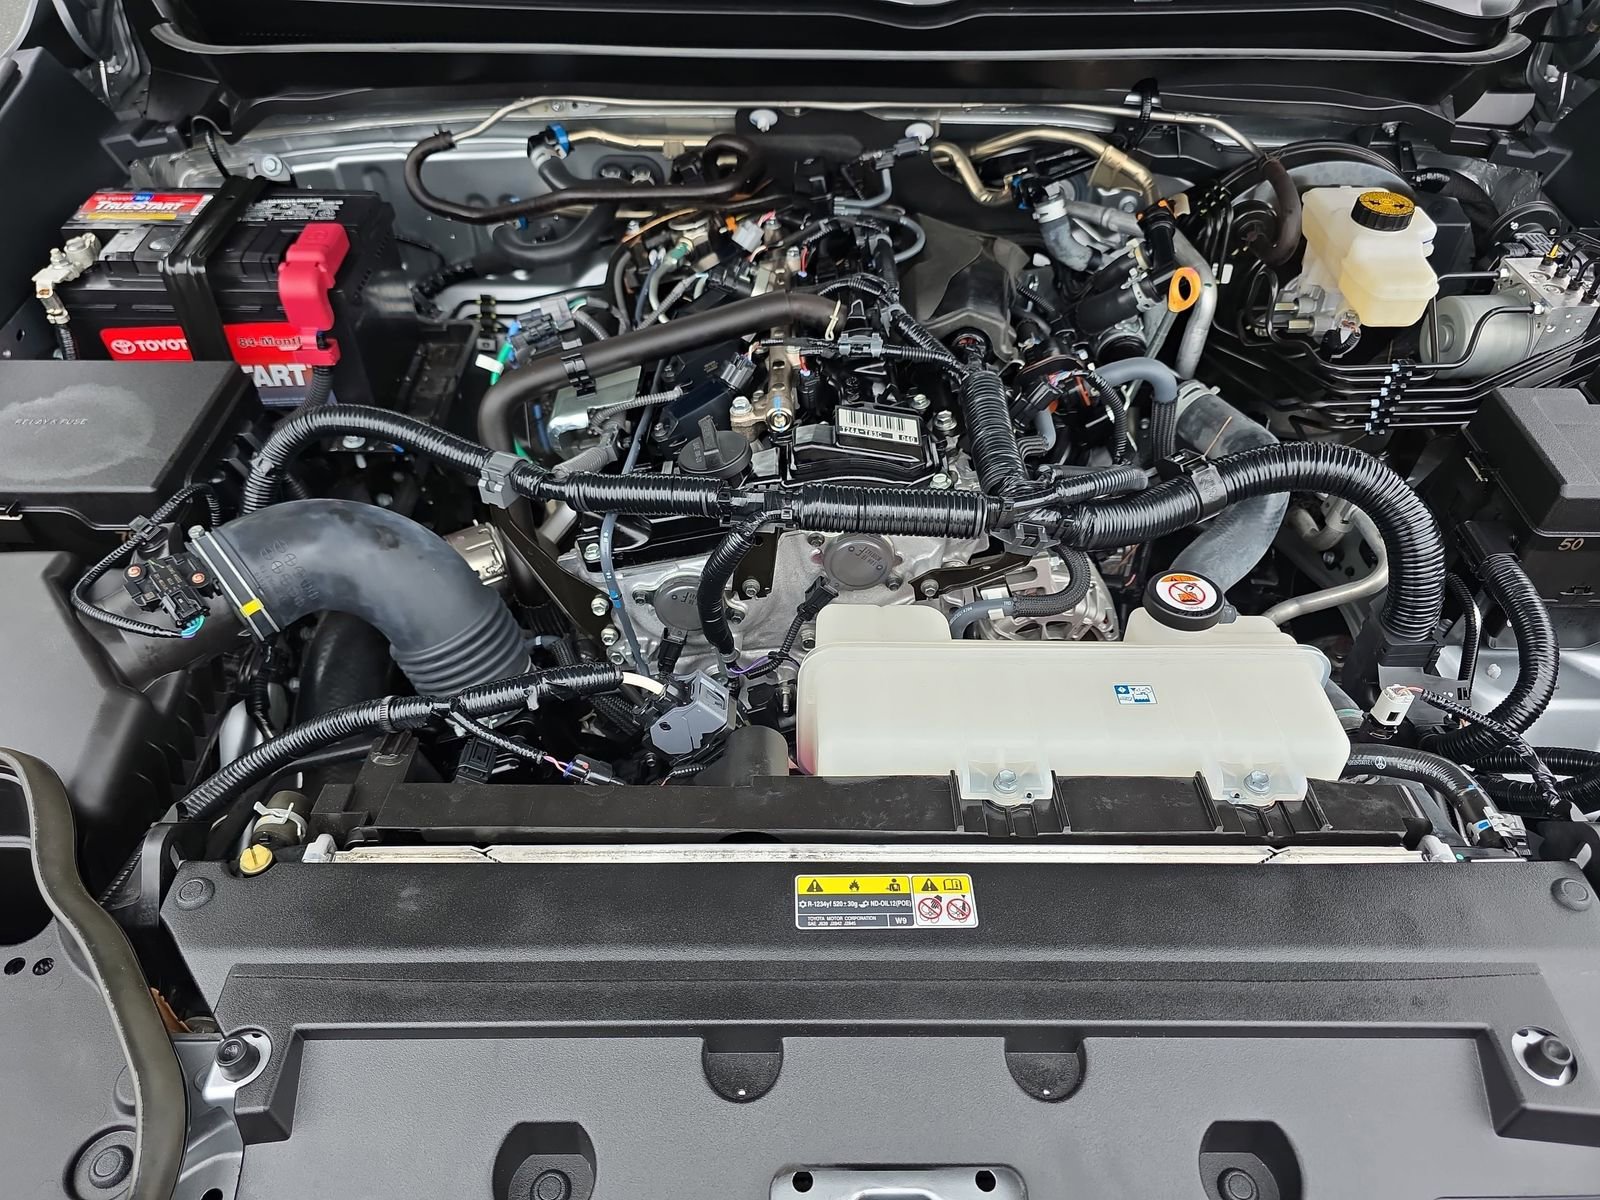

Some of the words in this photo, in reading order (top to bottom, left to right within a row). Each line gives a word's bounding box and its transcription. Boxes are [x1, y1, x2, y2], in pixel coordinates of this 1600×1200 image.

[133, 338, 188, 352] TOYOT
[1558, 537, 1585, 551] 50
[807, 900, 832, 908] R-1234yf
[870, 899, 911, 907] ND-OIL12(POE)
